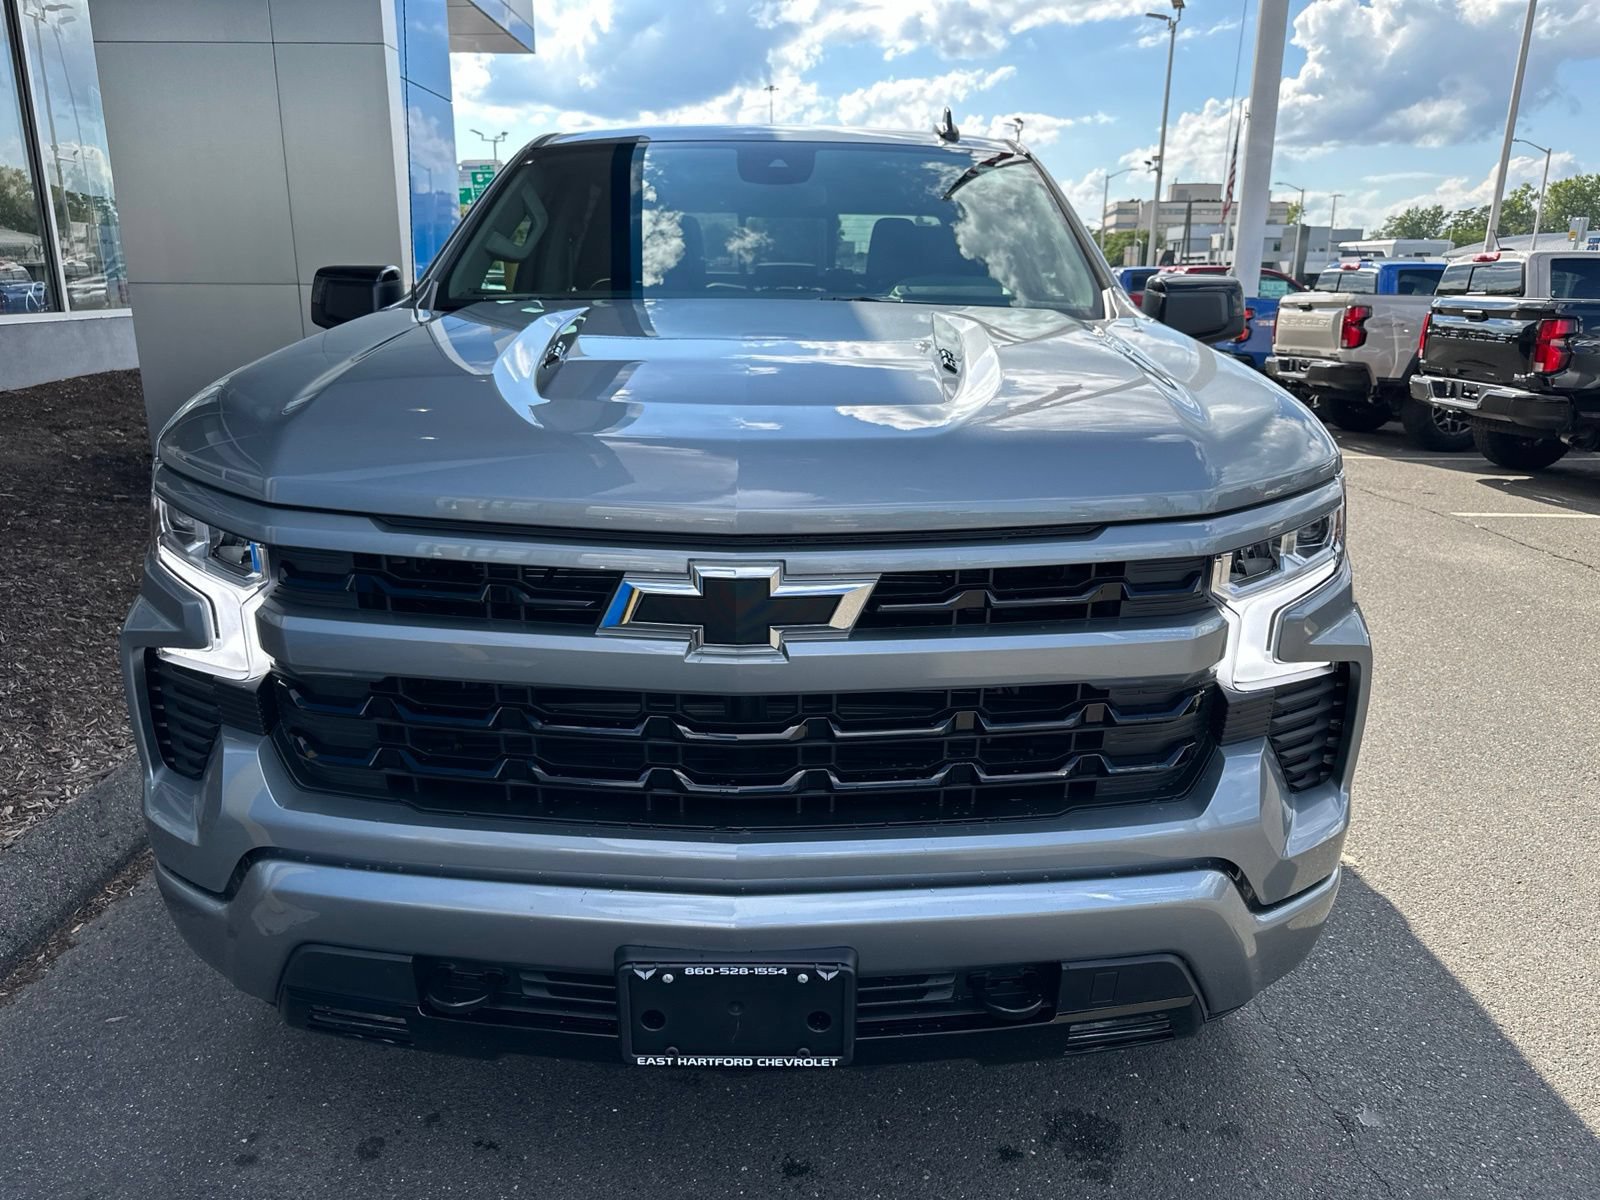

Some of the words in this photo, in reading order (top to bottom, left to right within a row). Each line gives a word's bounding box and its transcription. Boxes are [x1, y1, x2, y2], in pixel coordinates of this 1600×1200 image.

[684, 967, 788, 975] 860-528-1554
[636, 1057, 674, 1066] EAST
[677, 1057, 754, 1067] HARTFORD
[756, 1058, 839, 1067] CHEVROLET
